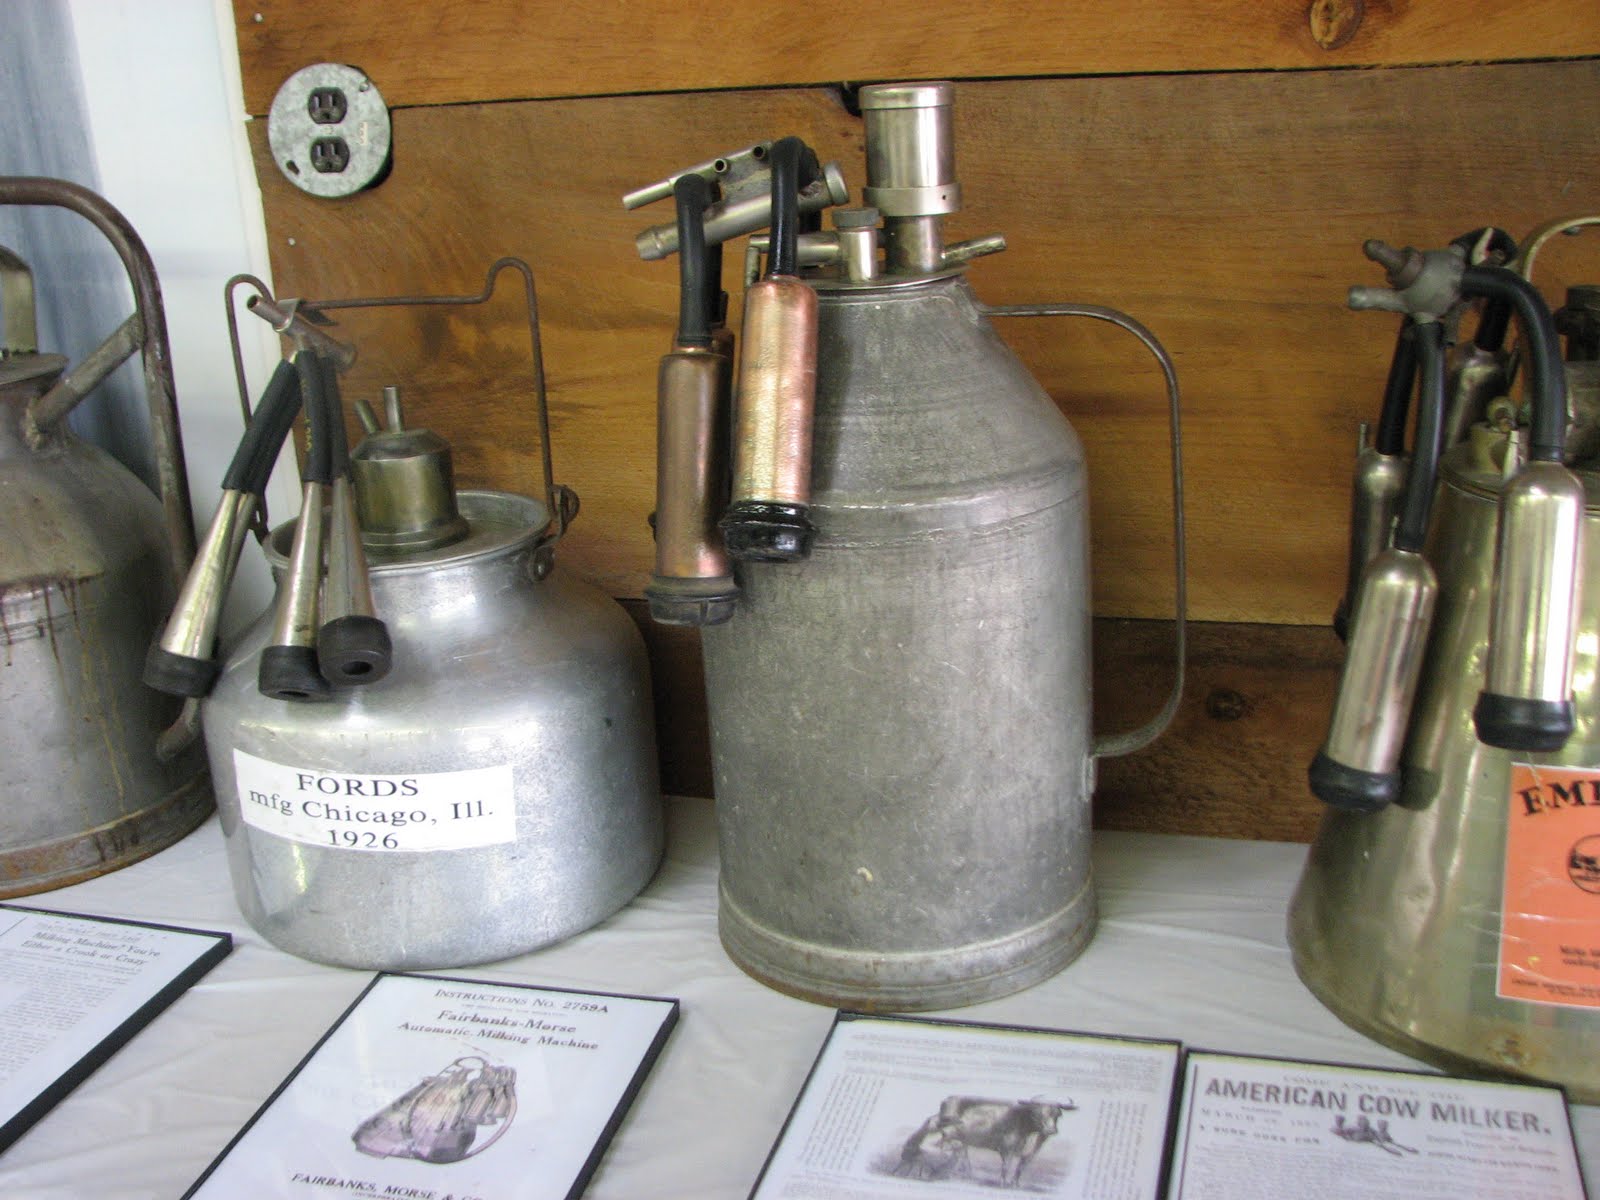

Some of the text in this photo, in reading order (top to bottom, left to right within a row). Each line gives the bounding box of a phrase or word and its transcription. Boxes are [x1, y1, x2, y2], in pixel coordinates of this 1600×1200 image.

[297, 773, 419, 797] FORDS
[249, 790, 494, 827] mfg Chicago, Ill.
[328, 829, 399, 849] 1926
[116, 954, 149, 966] Crazy
[127, 945, 161, 958] You're
[562, 1001, 609, 1014] 2759A
[437, 1010, 577, 1034] Fairbanks-Morse
[477, 1028, 532, 1045] Milking
[538, 1035, 600, 1050] Machine
[1205, 1077, 1552, 1135] AMERICAN COW MILKER.
